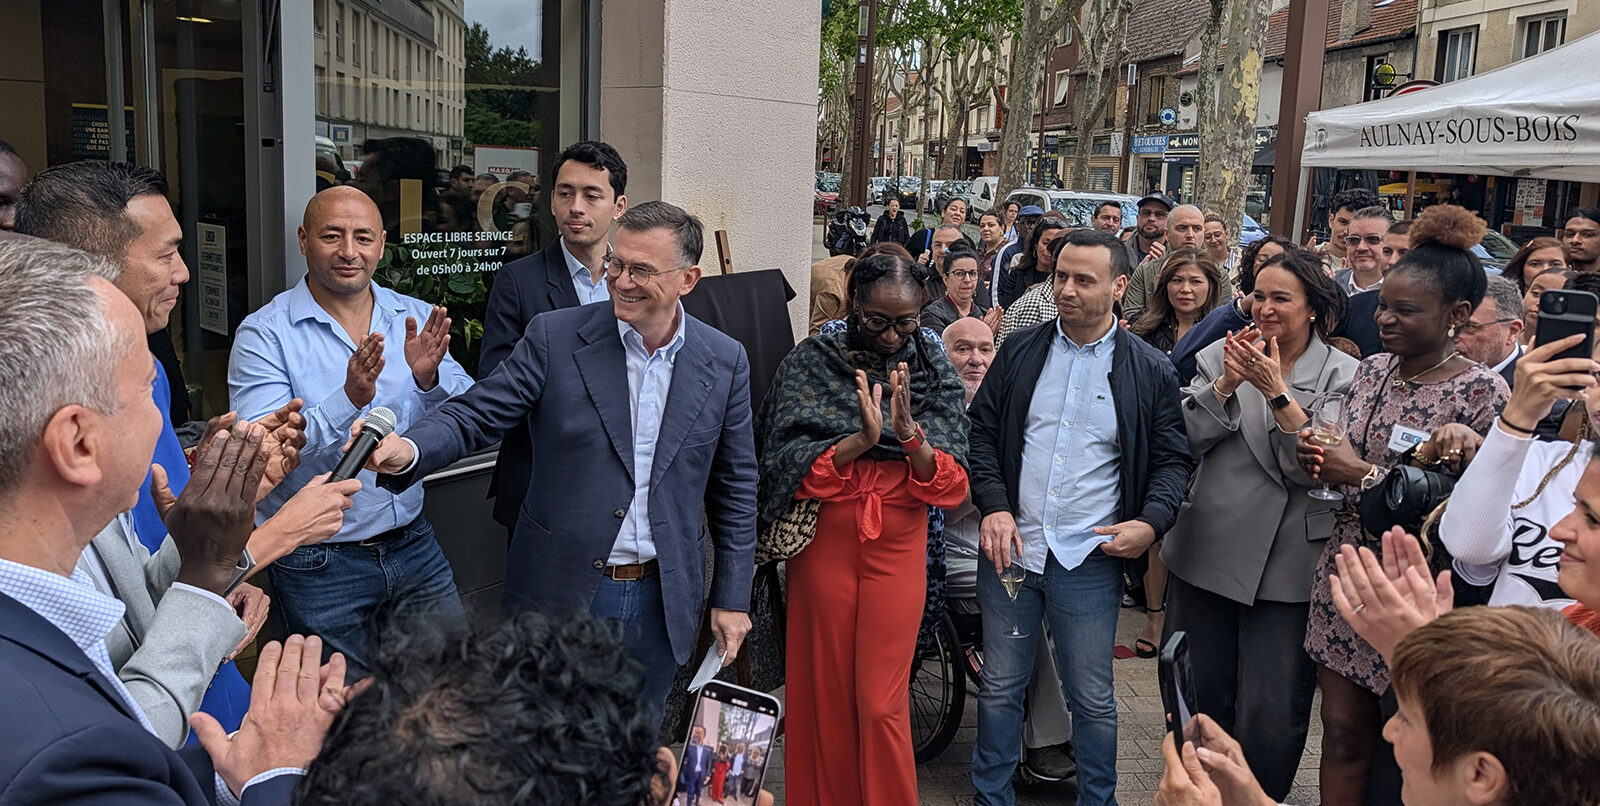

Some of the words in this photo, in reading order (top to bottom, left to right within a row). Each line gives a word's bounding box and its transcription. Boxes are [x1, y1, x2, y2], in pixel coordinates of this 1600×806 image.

[1360, 115, 1580, 147] AULNAY-SOUS-BOIS
[1134, 136, 1166, 147] RETOUCHES
[403, 232, 443, 244] ESPACE
[444, 231, 474, 243] LIBRE
[475, 230, 514, 242] SERVICE
[411, 249, 448, 260] Ouvert
[449, 248, 456, 259] 7
[457, 247, 483, 260] jours
[484, 248, 500, 257] sur
[500, 246, 507, 257] 7
[416, 264, 430, 276] de
[431, 263, 464, 275] 05h00
[465, 262, 472, 273] à
[473, 261, 503, 272] 24h00
[1402, 432, 1421, 445] CIC
